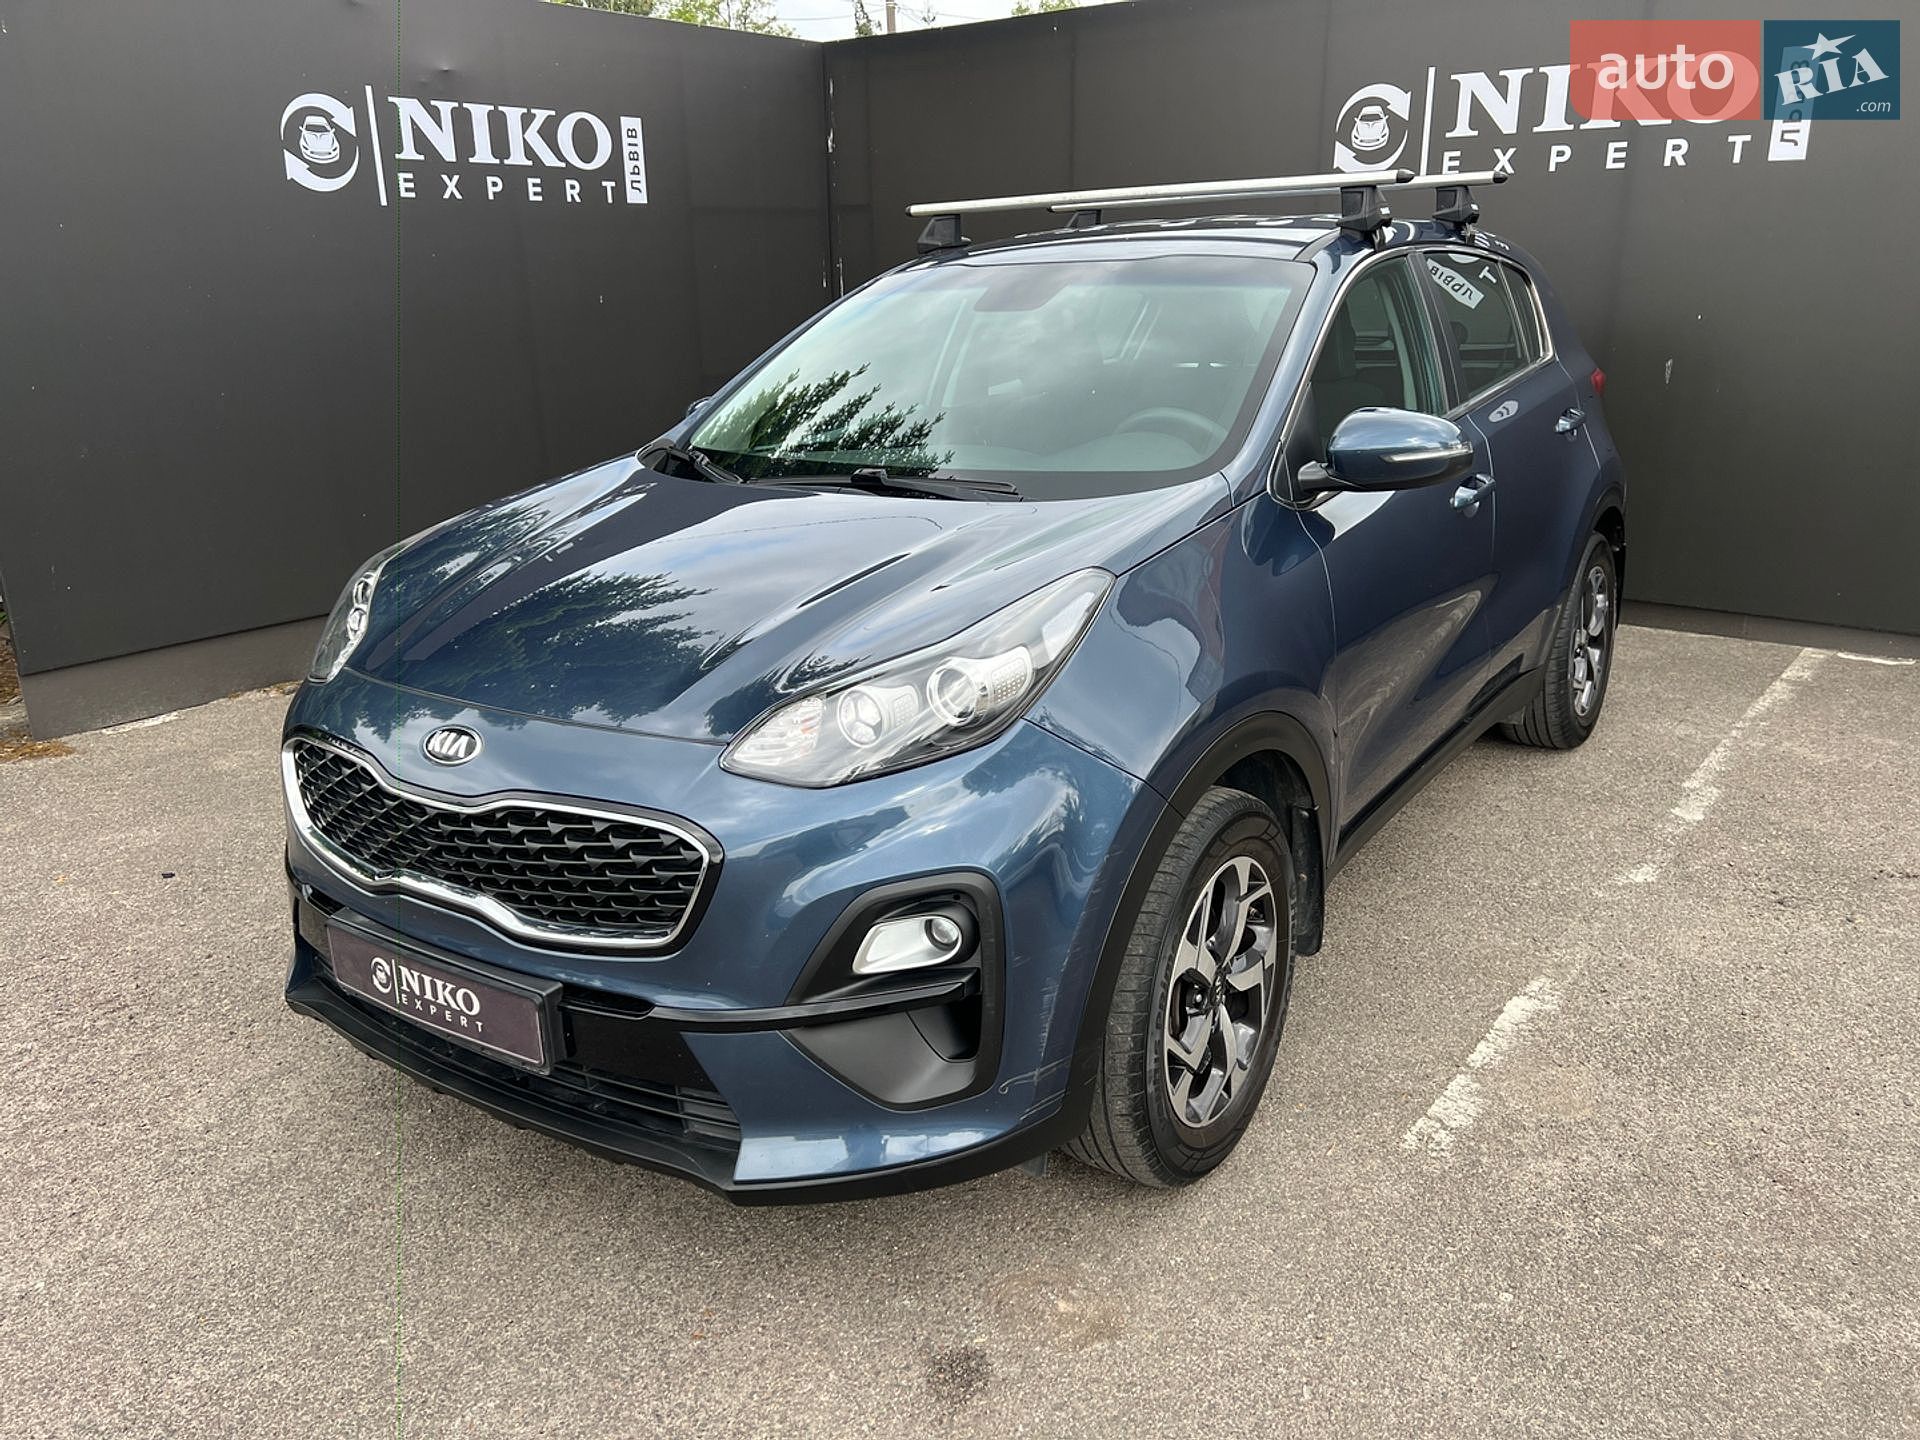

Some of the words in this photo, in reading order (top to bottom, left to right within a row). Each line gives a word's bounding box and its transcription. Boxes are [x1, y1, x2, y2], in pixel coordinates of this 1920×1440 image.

[1446, 50, 1760, 138] NIKO
[387, 96, 613, 171] NIKO
[1441, 134, 1752, 175] EXPERT
[397, 172, 617, 204] EXPERT
[399, 964, 481, 1017] NIKO
[401, 993, 485, 1034] EXPERT
